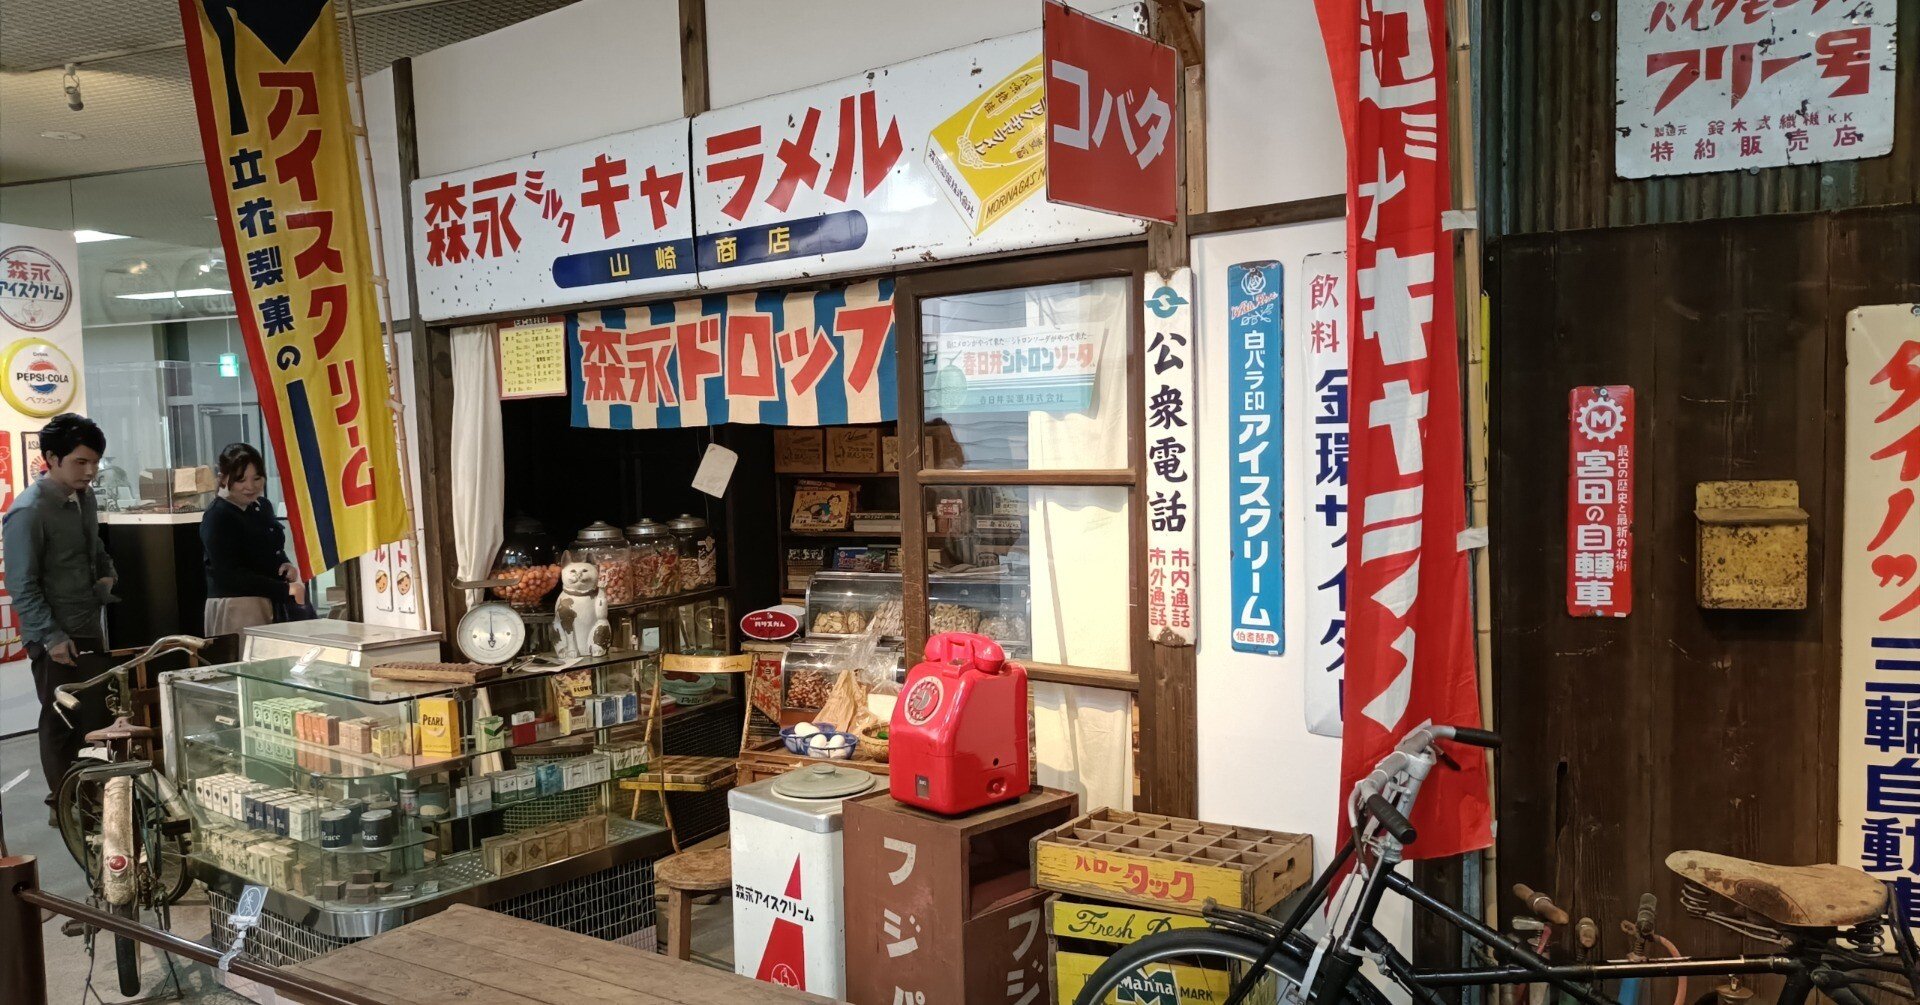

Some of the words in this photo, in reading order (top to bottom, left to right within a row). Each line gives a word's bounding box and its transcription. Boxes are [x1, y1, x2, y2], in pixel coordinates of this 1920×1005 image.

[1647, 27, 1872, 116] フリー号
[1051, 59, 1172, 170] コバタ
[1707, 112, 1820, 135] 鈴木式織機
[1650, 124, 1860, 162] 特約販売店
[7, 260, 51, 281] 森永
[229, 147, 301, 371] 立花製菓の
[609, 226, 790, 278] 山崎商店
[259, 71, 377, 507] アイスクリーム
[1308, 274, 1340, 354] 飲料
[579, 303, 895, 404] 森永ドロップ
[1147, 332, 1188, 532] 公衆電話
[1591, 410, 1611, 428] M
[28, 441, 40, 449] ASA
[1149, 547, 1167, 627] 市外通話
[1171, 547, 1190, 629] 市内通話
[422, 714, 444, 726] PEARL
[735, 884, 814, 922] 森永アイスクリーム
[1074, 854, 1195, 904] ハロータック
[1067, 909, 1135, 940] Fresh
[1180, 986, 1213, 1001] MARK
